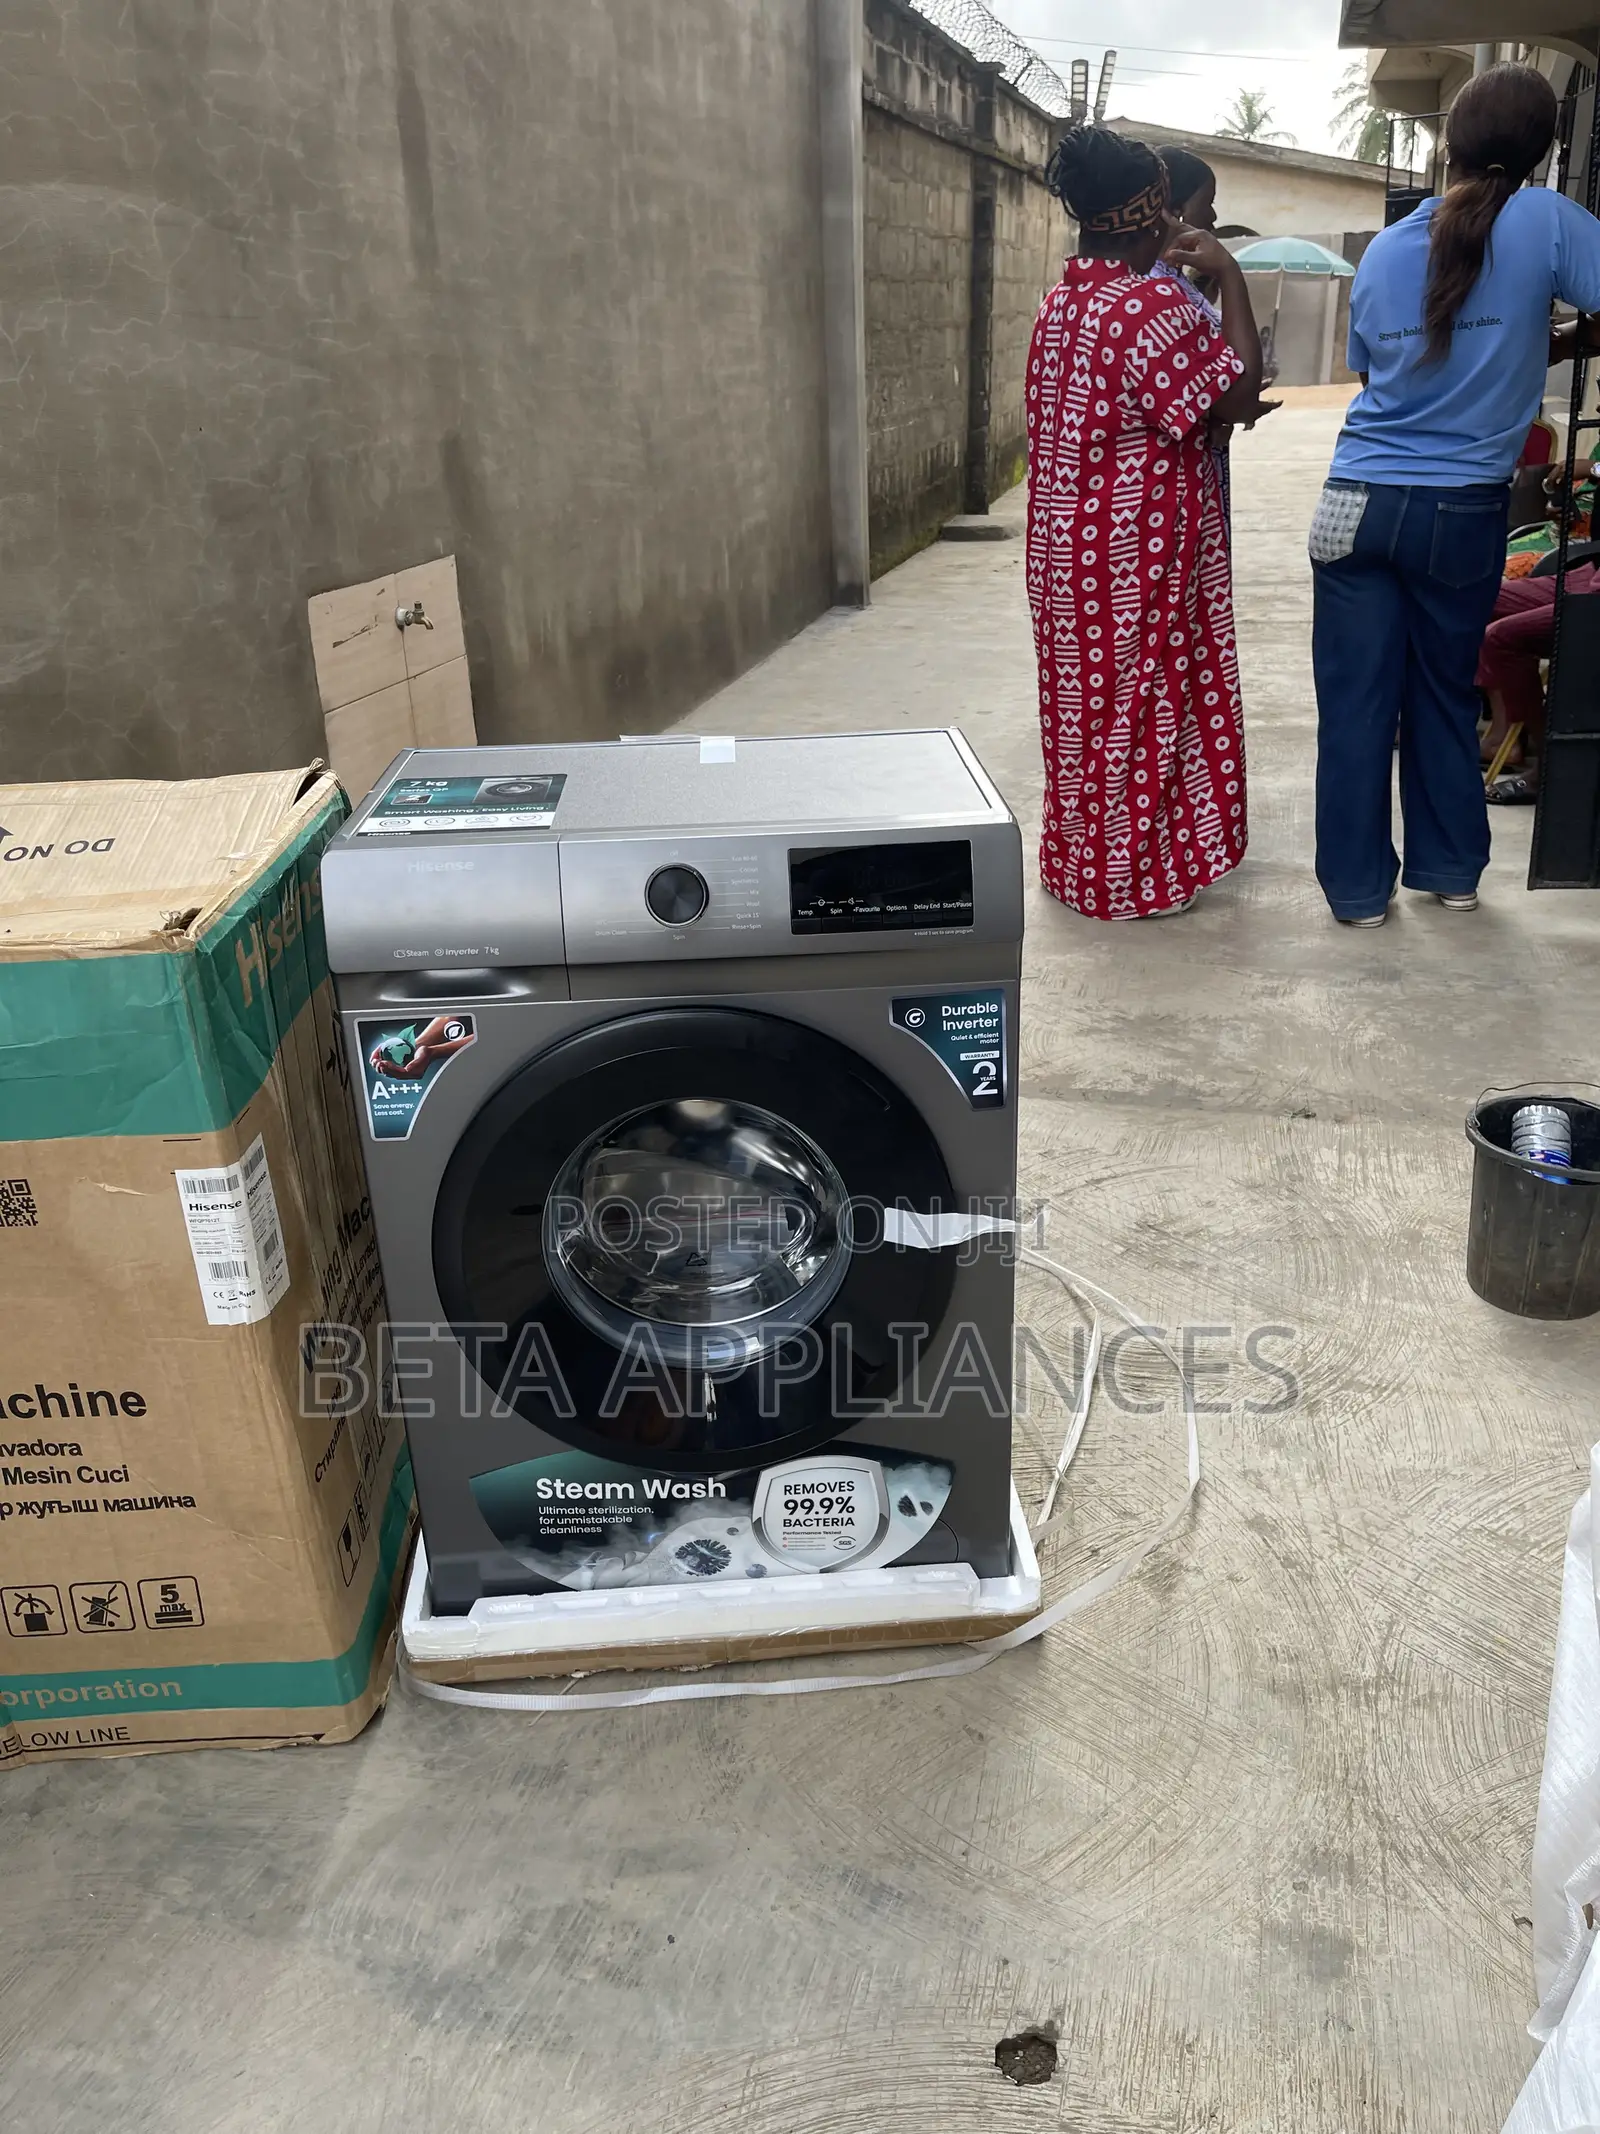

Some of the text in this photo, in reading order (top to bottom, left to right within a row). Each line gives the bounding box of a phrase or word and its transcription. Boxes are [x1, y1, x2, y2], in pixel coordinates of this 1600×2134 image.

[1457, 319, 1474, 331] day
[1475, 315, 1503, 327] shine.
[64, 838, 116, 855] DO
[407, 860, 475, 874] Hisense
[830, 907, 843, 915] Spin
[913, 903, 929, 911] Delay
[942, 901, 973, 909] Start/Pause
[406, 949, 430, 958] Steam
[445, 947, 479, 957] Inverter
[941, 1002, 999, 1017] Durable
[943, 1018, 999, 1031] Inverter
[972, 1061, 998, 1096] 2
[372, 1081, 422, 1100] A+++
[188, 1200, 243, 1212] Hisense
[0, 1383, 148, 1419] chine
[0, 1439, 83, 1457] vadora
[1, 1464, 130, 1486] Mesin Cuci
[536, 1477, 727, 1499] Steam Wash
[783, 1481, 855, 1496] REMOVES
[102, 1495, 197, 1513] машина
[538, 1506, 586, 1516] Ultimate
[783, 1496, 856, 1516] 99.9%
[539, 1515, 633, 1526] for unmistakable
[782, 1517, 856, 1528] BACTERIA
[539, 1526, 603, 1536] cleanliness
[838, 1539, 853, 1547] SGS
[160, 1584, 181, 1604] 5
[159, 1602, 186, 1613] max
[0, 1726, 131, 1756] ELOW LINE
